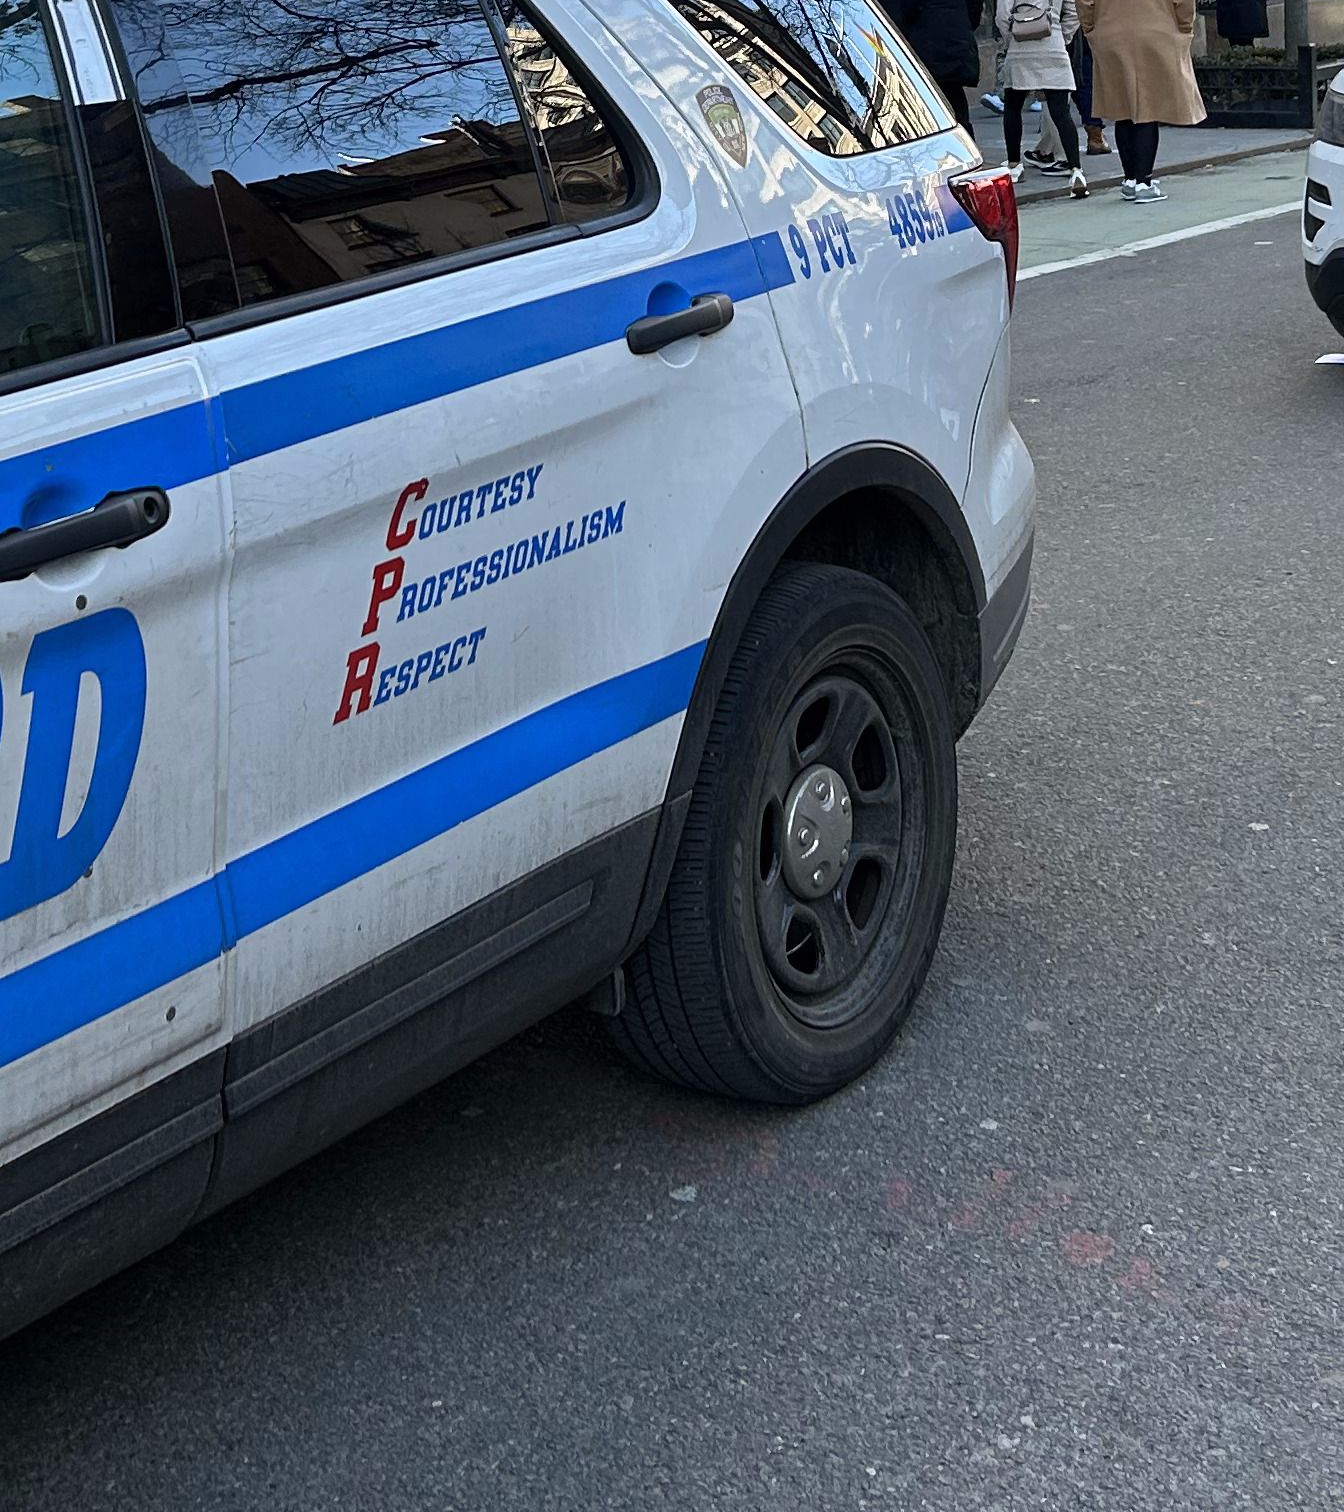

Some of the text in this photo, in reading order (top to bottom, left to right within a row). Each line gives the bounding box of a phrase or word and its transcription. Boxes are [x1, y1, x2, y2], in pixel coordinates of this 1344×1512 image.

[787, 210, 857, 280] 9 PCT
[886, 189, 935, 250] 4859
